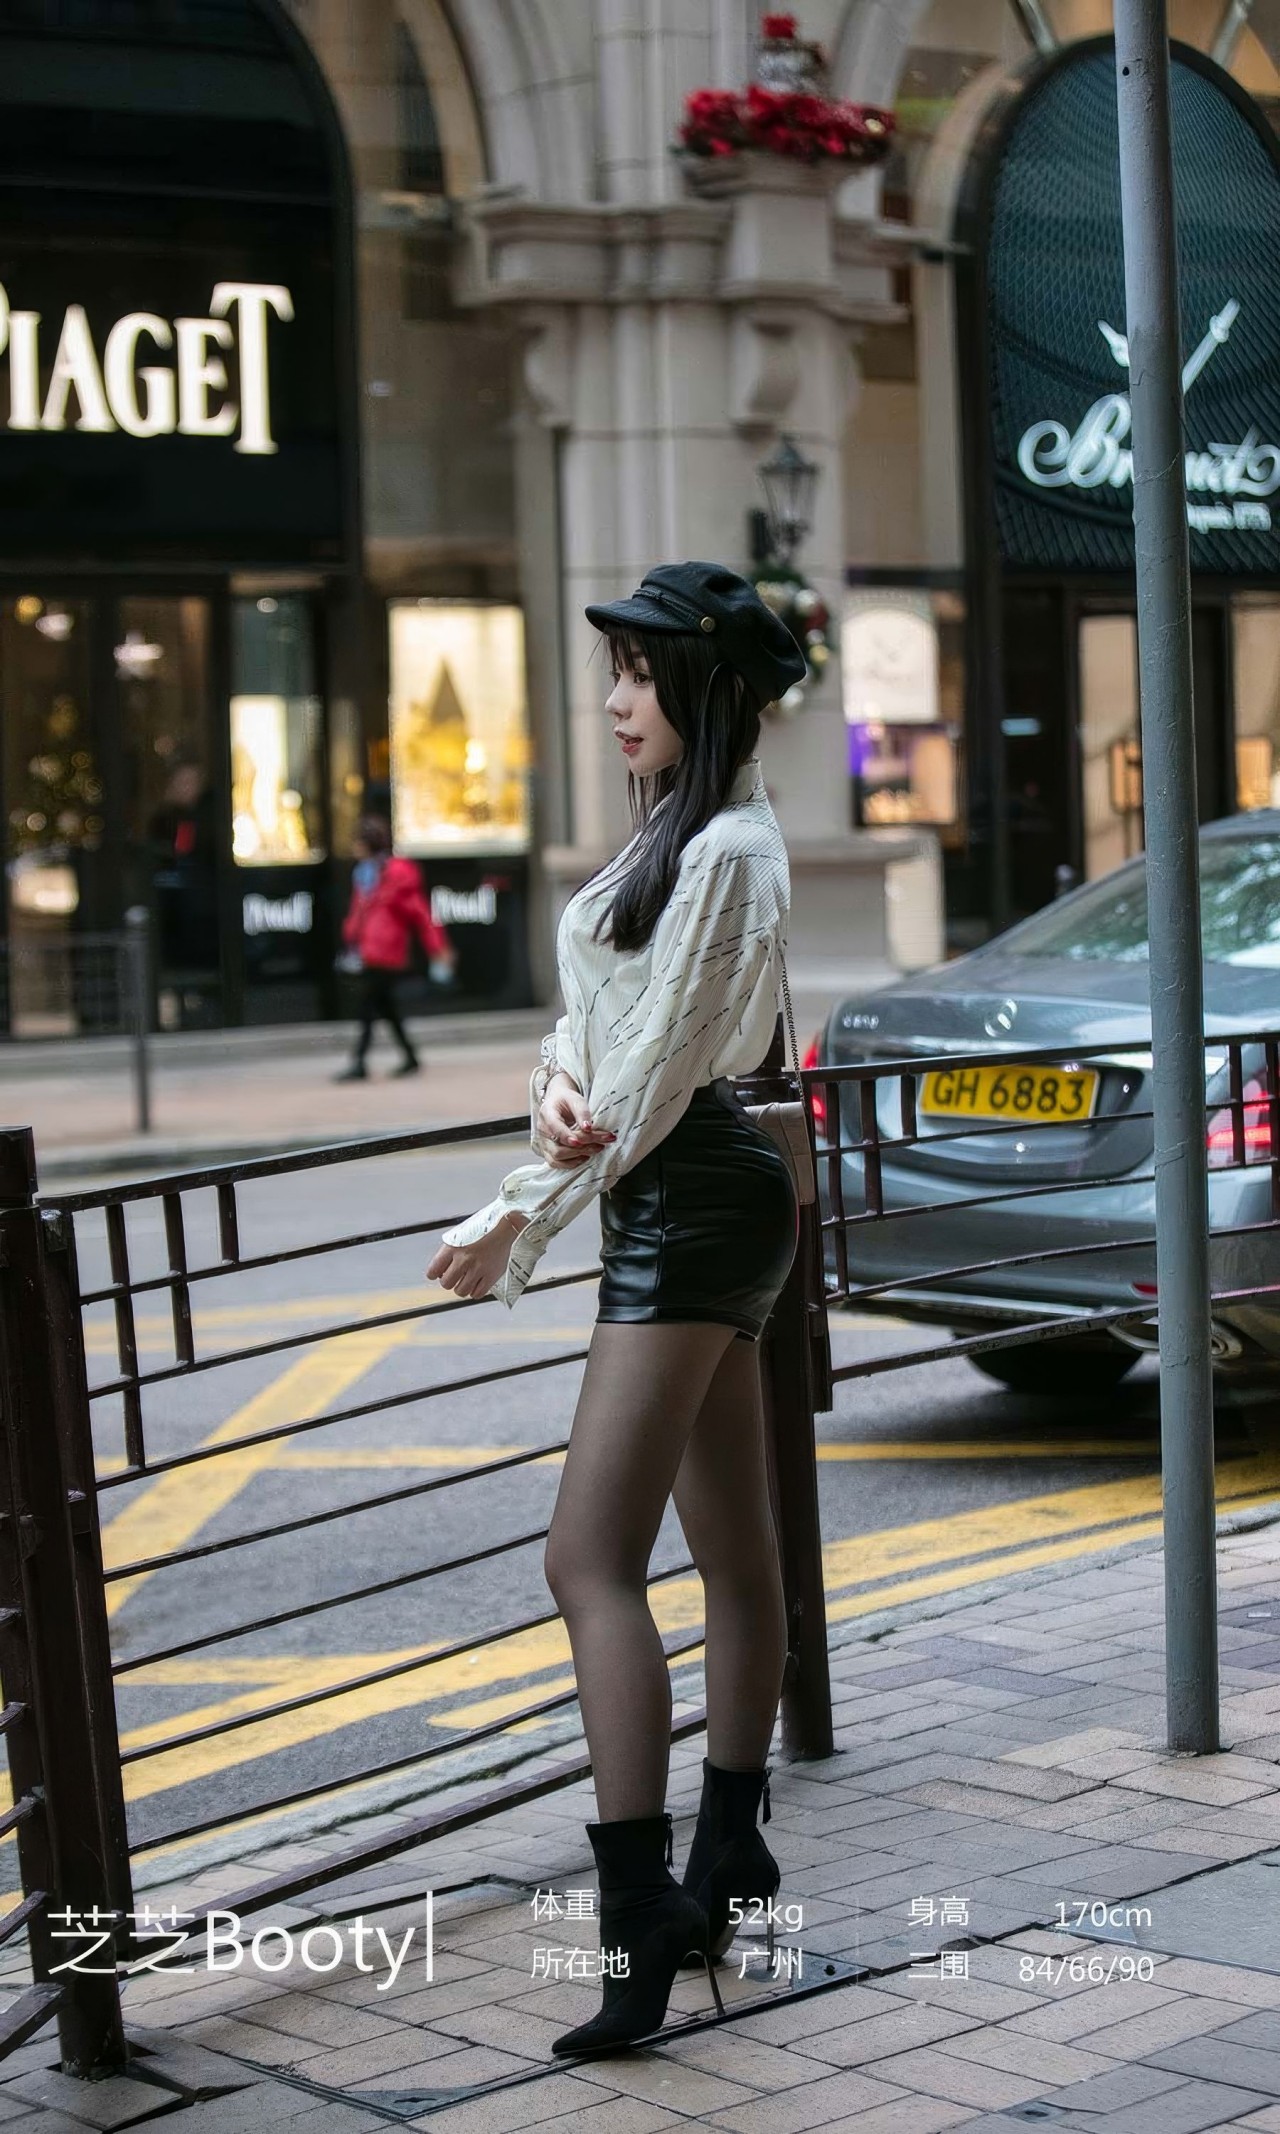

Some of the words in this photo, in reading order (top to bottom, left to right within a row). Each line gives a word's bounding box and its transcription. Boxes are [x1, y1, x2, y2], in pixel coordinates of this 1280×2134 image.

[0, 281, 296, 455] IAGET
[933, 1071, 980, 1108] GH
[989, 1073, 1085, 1115] 6883
